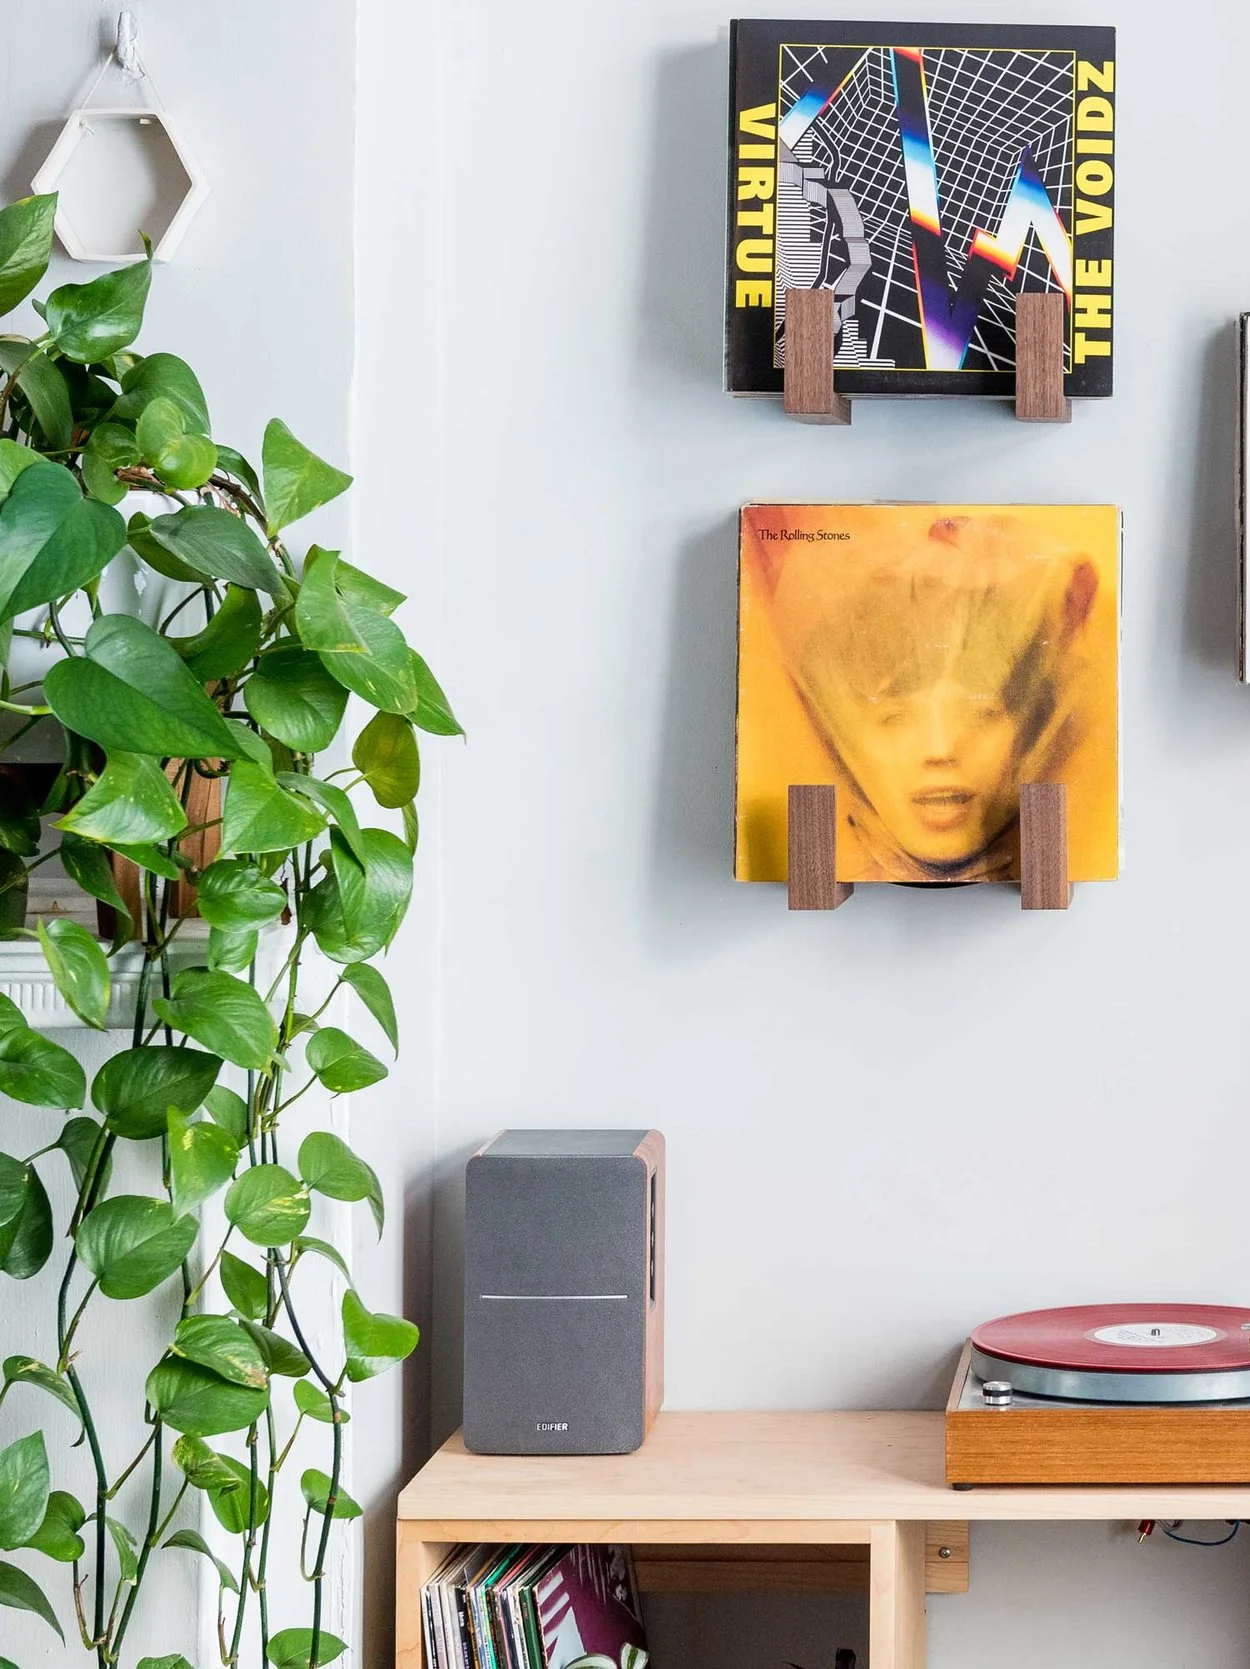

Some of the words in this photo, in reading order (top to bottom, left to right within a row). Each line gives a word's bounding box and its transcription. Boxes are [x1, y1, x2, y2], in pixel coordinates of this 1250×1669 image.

[1075, 61, 1115, 236] VOIDZ
[735, 102, 777, 308] VIRTUE
[1074, 259, 1113, 364] THE
[758, 529, 778, 541] The
[780, 529, 815, 543] Rolling
[816, 529, 851, 541] Stones
[536, 1422, 569, 1431] EDIFIER
